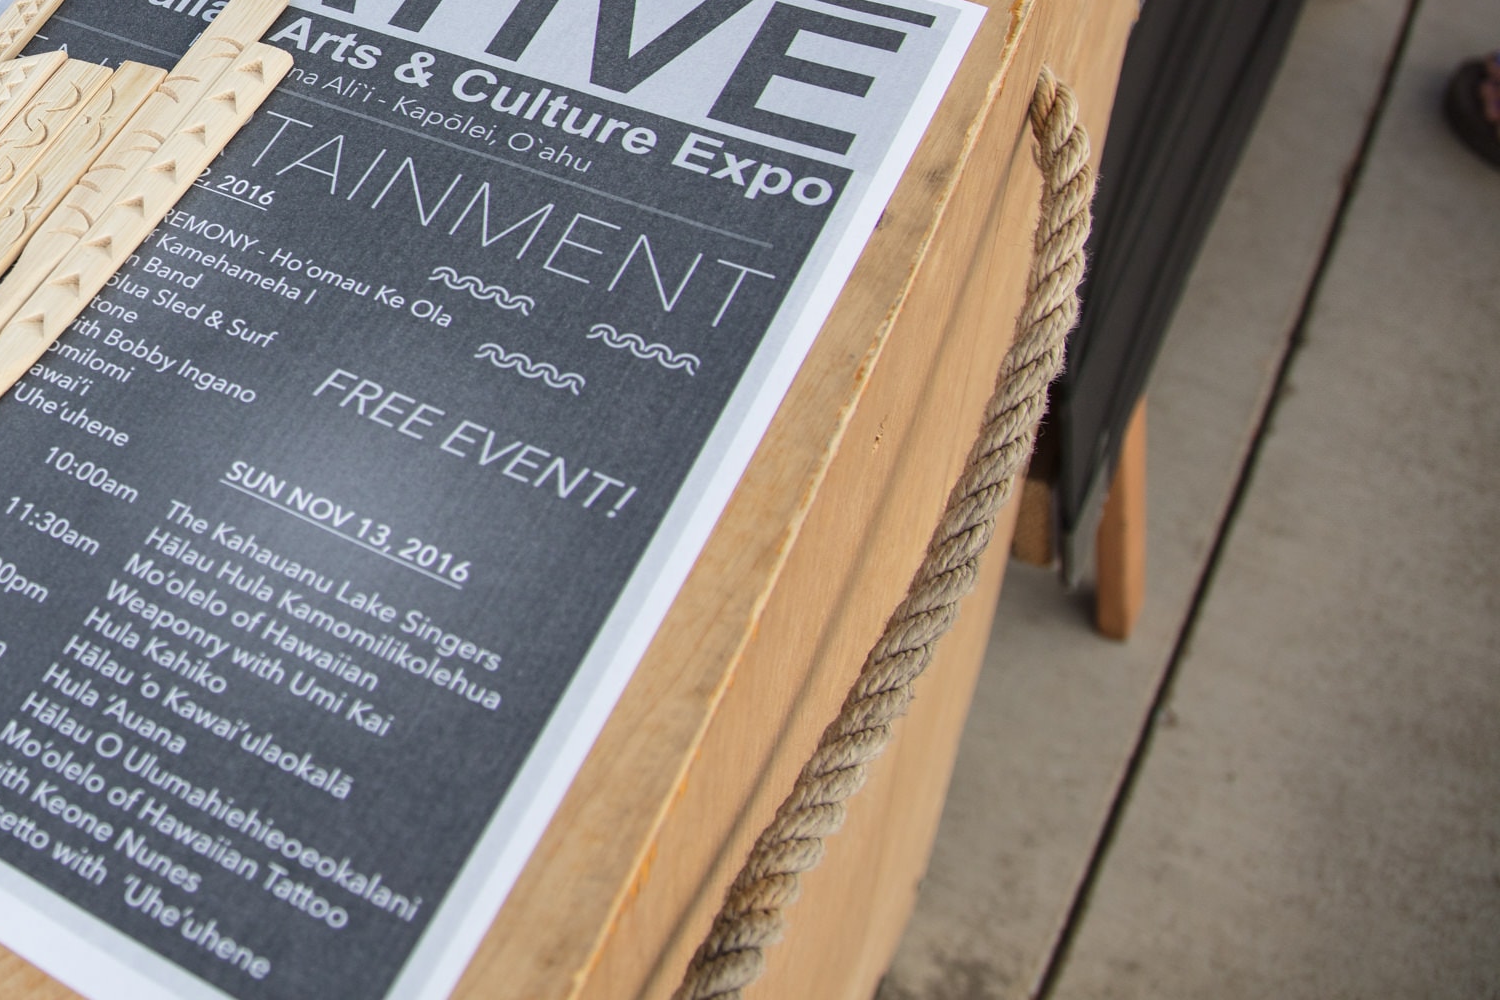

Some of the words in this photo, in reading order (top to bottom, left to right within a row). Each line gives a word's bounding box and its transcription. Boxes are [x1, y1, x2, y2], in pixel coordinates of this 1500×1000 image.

[268, 16, 383, 71] Arts
[393, 50, 437, 89] &
[451, 68, 658, 155] Culture
[671, 131, 834, 207] Expo
[391, 94, 499, 146] Kapōlei,
[217, 175, 277, 207] 2016
[252, 110, 777, 328] TAINMENT
[89, 294, 139, 325] tone
[107, 272, 150, 300] ōlua
[153, 287, 206, 321] Sled
[204, 309, 224, 331] &
[226, 316, 280, 349] Surf
[143, 254, 204, 291] Band
[156, 232, 301, 301] Kamehameha
[163, 207, 260, 254] REMONY
[374, 285, 405, 308] Ke
[410, 298, 453, 329] Ola
[29, 361, 94, 397] awai'i
[47, 338, 136, 384] omilomi
[72, 315, 102, 340] ith
[103, 326, 178, 373] Bobby
[177, 358, 257, 404] Ingano
[44, 445, 139, 504] 10:00am
[312, 367, 447, 440] FREE
[440, 419, 638, 519] EVENT!
[4, 495, 101, 556] 11:30am
[226, 460, 287, 499] SUN
[285, 485, 355, 529] NOV
[357, 516, 393, 554] 13,
[398, 537, 473, 584] 2016
[144, 525, 216, 574] Hālau
[216, 559, 276, 604] Hula
[277, 588, 502, 712] Kamomilikolehua
[165, 498, 210, 535] The
[209, 523, 335, 594] Kahauanu
[335, 580, 399, 625] Lake
[400, 608, 504, 673] Singers
[41, 662, 100, 708] Hula
[62, 634, 135, 687] Hālau
[83, 606, 142, 650] Hula
[141, 635, 230, 695] Kahiko
[105, 578, 232, 658] Weaponry
[231, 643, 286, 685] with
[288, 669, 348, 714] Umi
[346, 697, 396, 738] Kai
[231, 604, 263, 633] of
[261, 620, 381, 692] Hawaiian
[19, 690, 94, 745] Hālau
[94, 732, 124, 759] O
[121, 745, 424, 923] Ulumahiehieoeokalani
[29, 780, 116, 844] Keone
[113, 826, 204, 895] Nunes
[51, 837, 110, 885] with
[106, 784, 142, 812] of
[137, 796, 260, 881] Hawaiian
[262, 862, 350, 931] Tattoo
